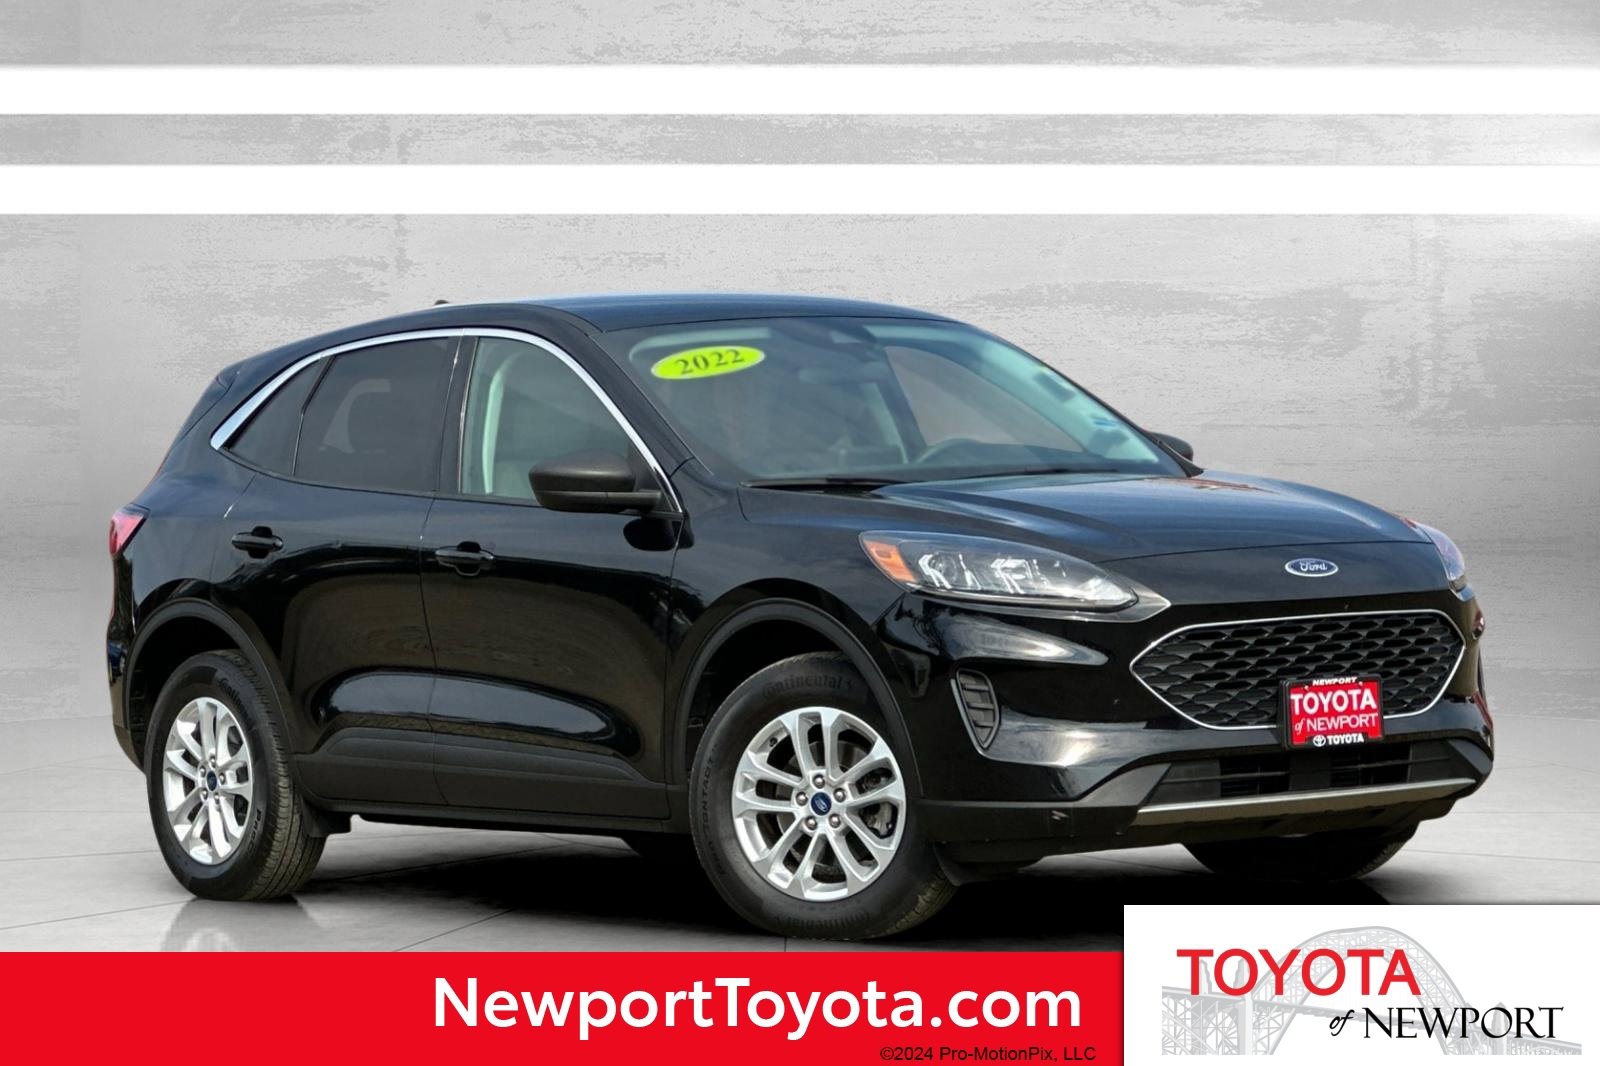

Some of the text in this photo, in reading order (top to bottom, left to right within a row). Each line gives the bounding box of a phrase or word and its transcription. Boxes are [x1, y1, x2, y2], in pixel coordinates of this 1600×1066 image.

[674, 348, 745, 375] 2022
[1298, 560, 1328, 572] Ford
[1312, 676, 1359, 686] NEWPORT
[1290, 688, 1378, 716] TOYOTA
[1294, 713, 1379, 736] of NEWPORT
[1326, 733, 1365, 746] TOYOTA
